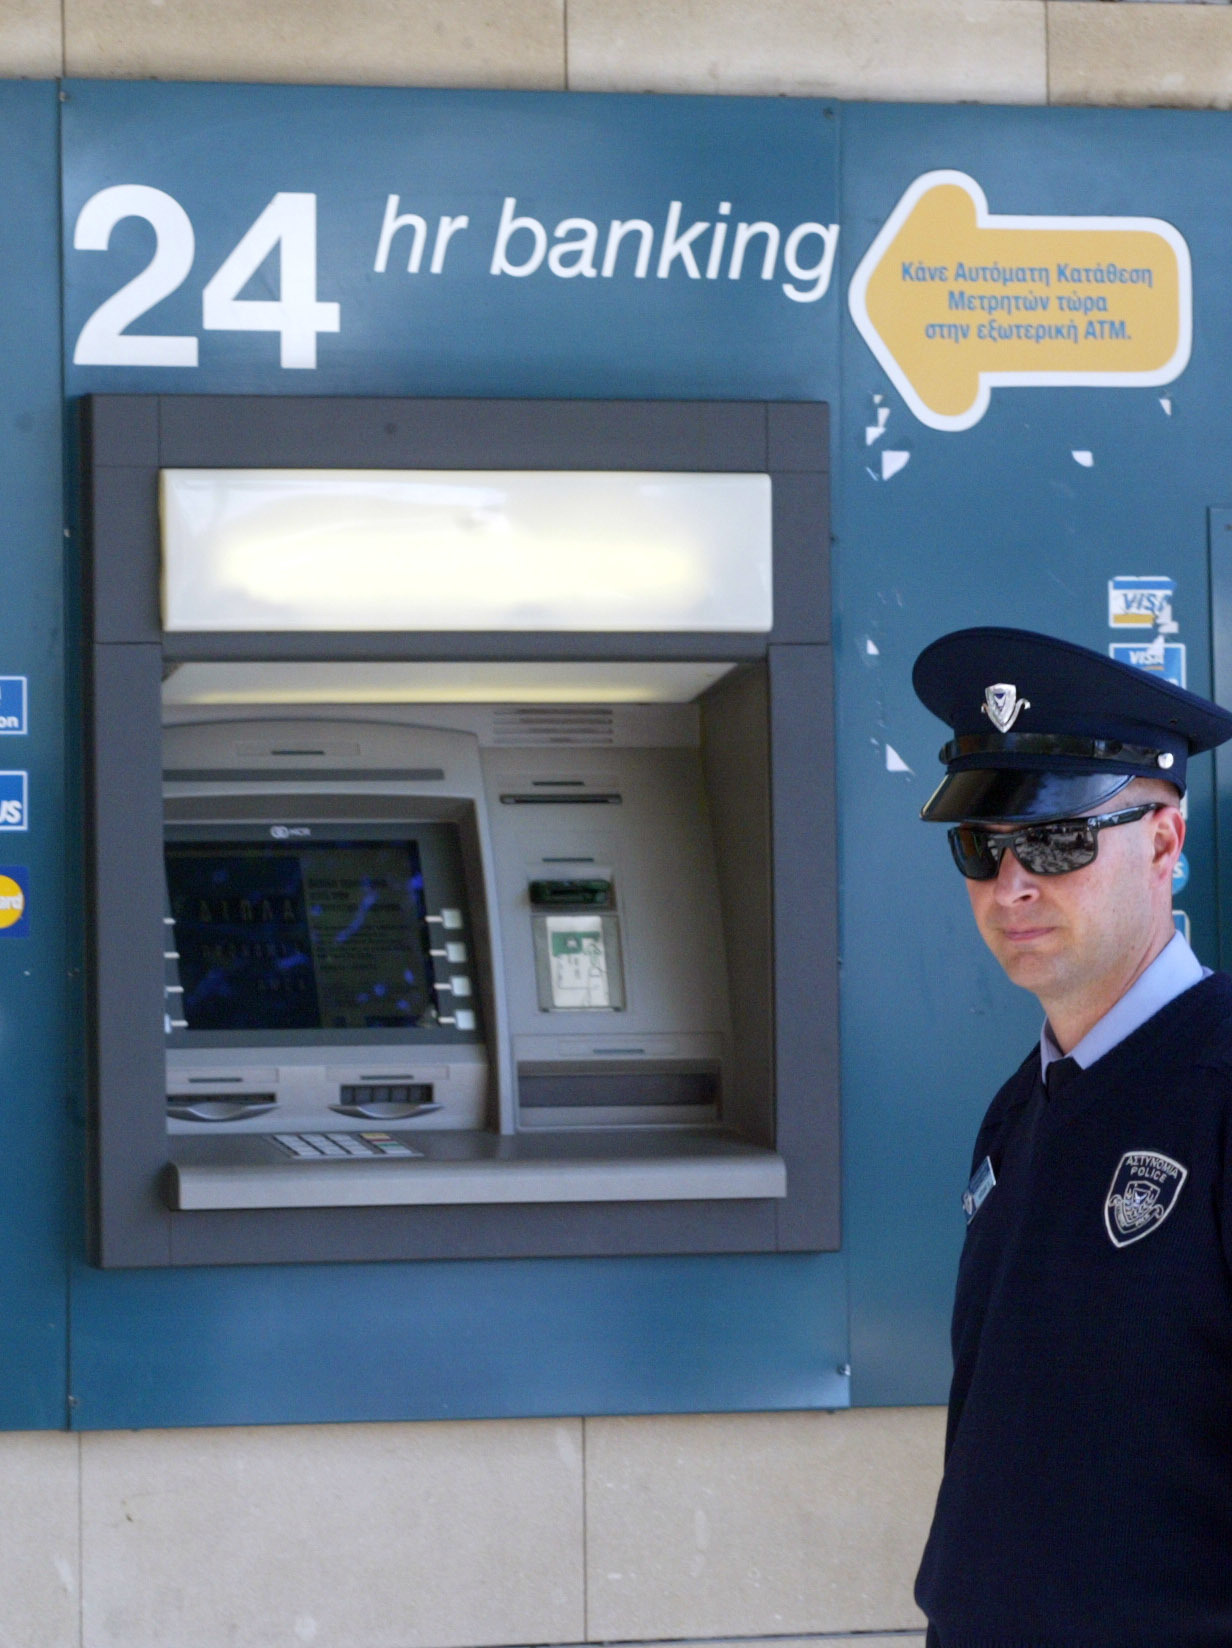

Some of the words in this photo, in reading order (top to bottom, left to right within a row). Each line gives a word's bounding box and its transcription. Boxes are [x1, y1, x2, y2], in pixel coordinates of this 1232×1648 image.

[73, 184, 341, 370] 24
[374, 194, 469, 275] hr
[490, 197, 840, 302] banking
[901, 261, 949, 283] Κάνε
[953, 261, 1051, 287] Αυτόματη
[1056, 262, 1154, 288] Κατάθεση
[947, 289, 1050, 315] Μετρητών
[1056, 295, 1108, 316] τώρα
[924, 321, 970, 344] στην
[976, 319, 1080, 345] εξωτερική
[1130, 1166, 1168, 1183] POLICE
